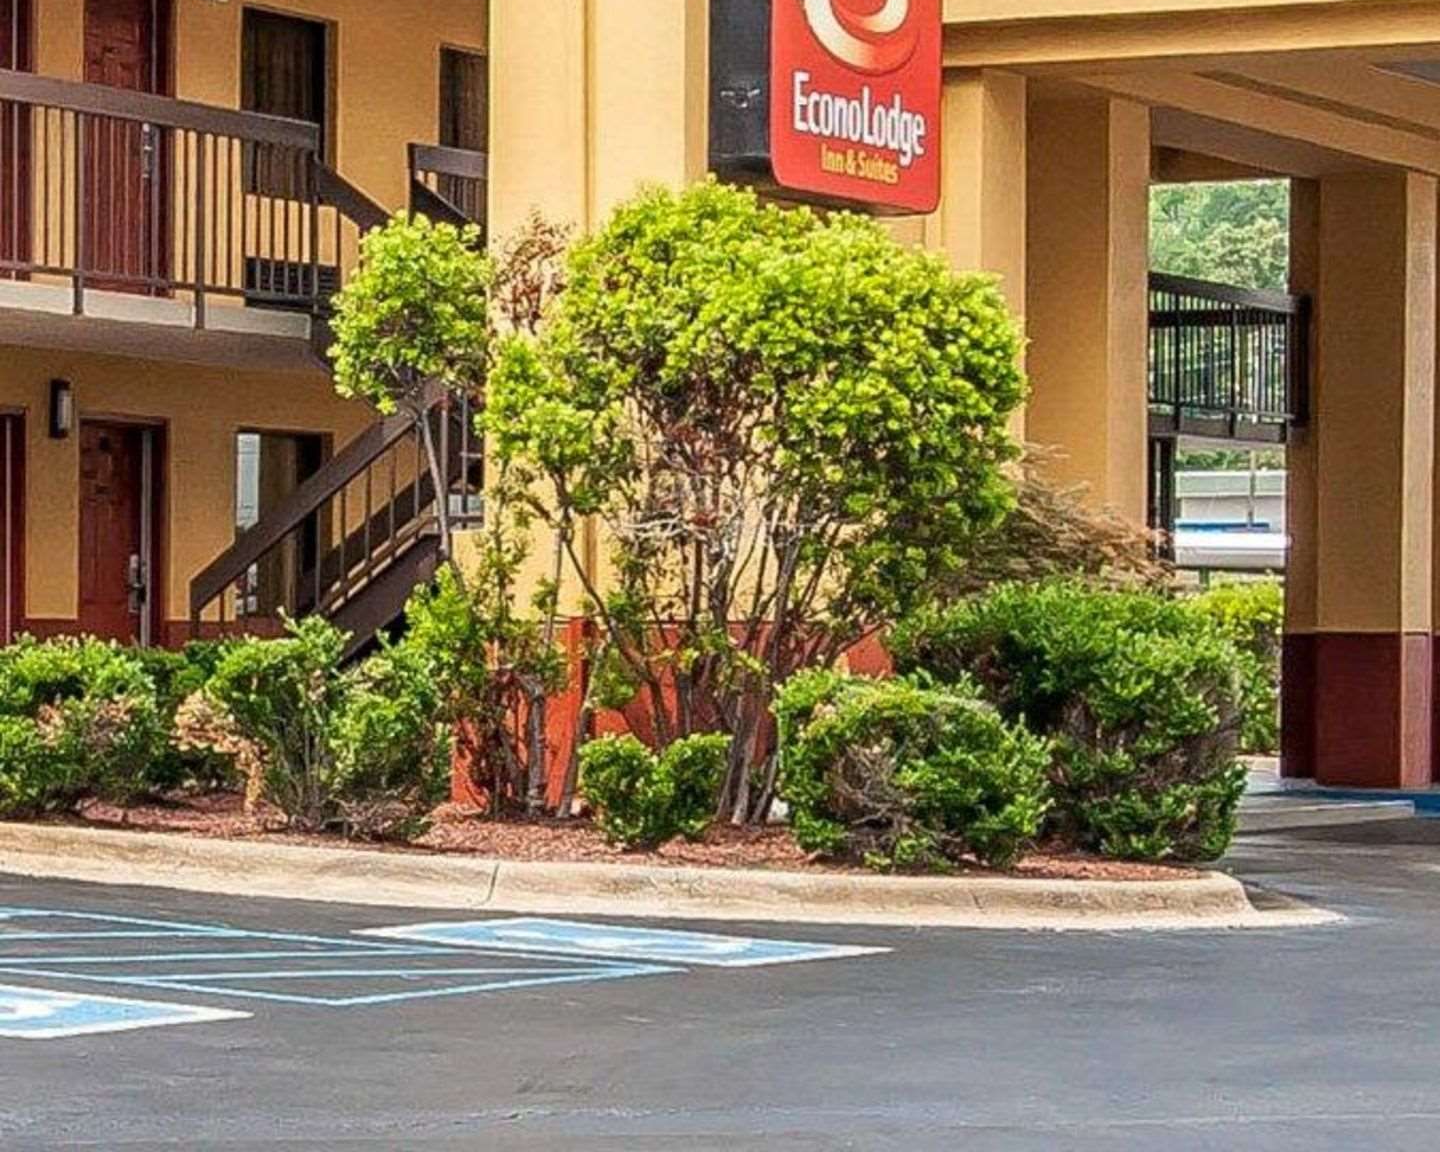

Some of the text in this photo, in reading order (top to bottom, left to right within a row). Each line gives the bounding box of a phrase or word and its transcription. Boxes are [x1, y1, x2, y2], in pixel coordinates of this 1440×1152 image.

[793, 70, 926, 167] EconoLodge
[821, 142, 899, 184] Inn & Suites
